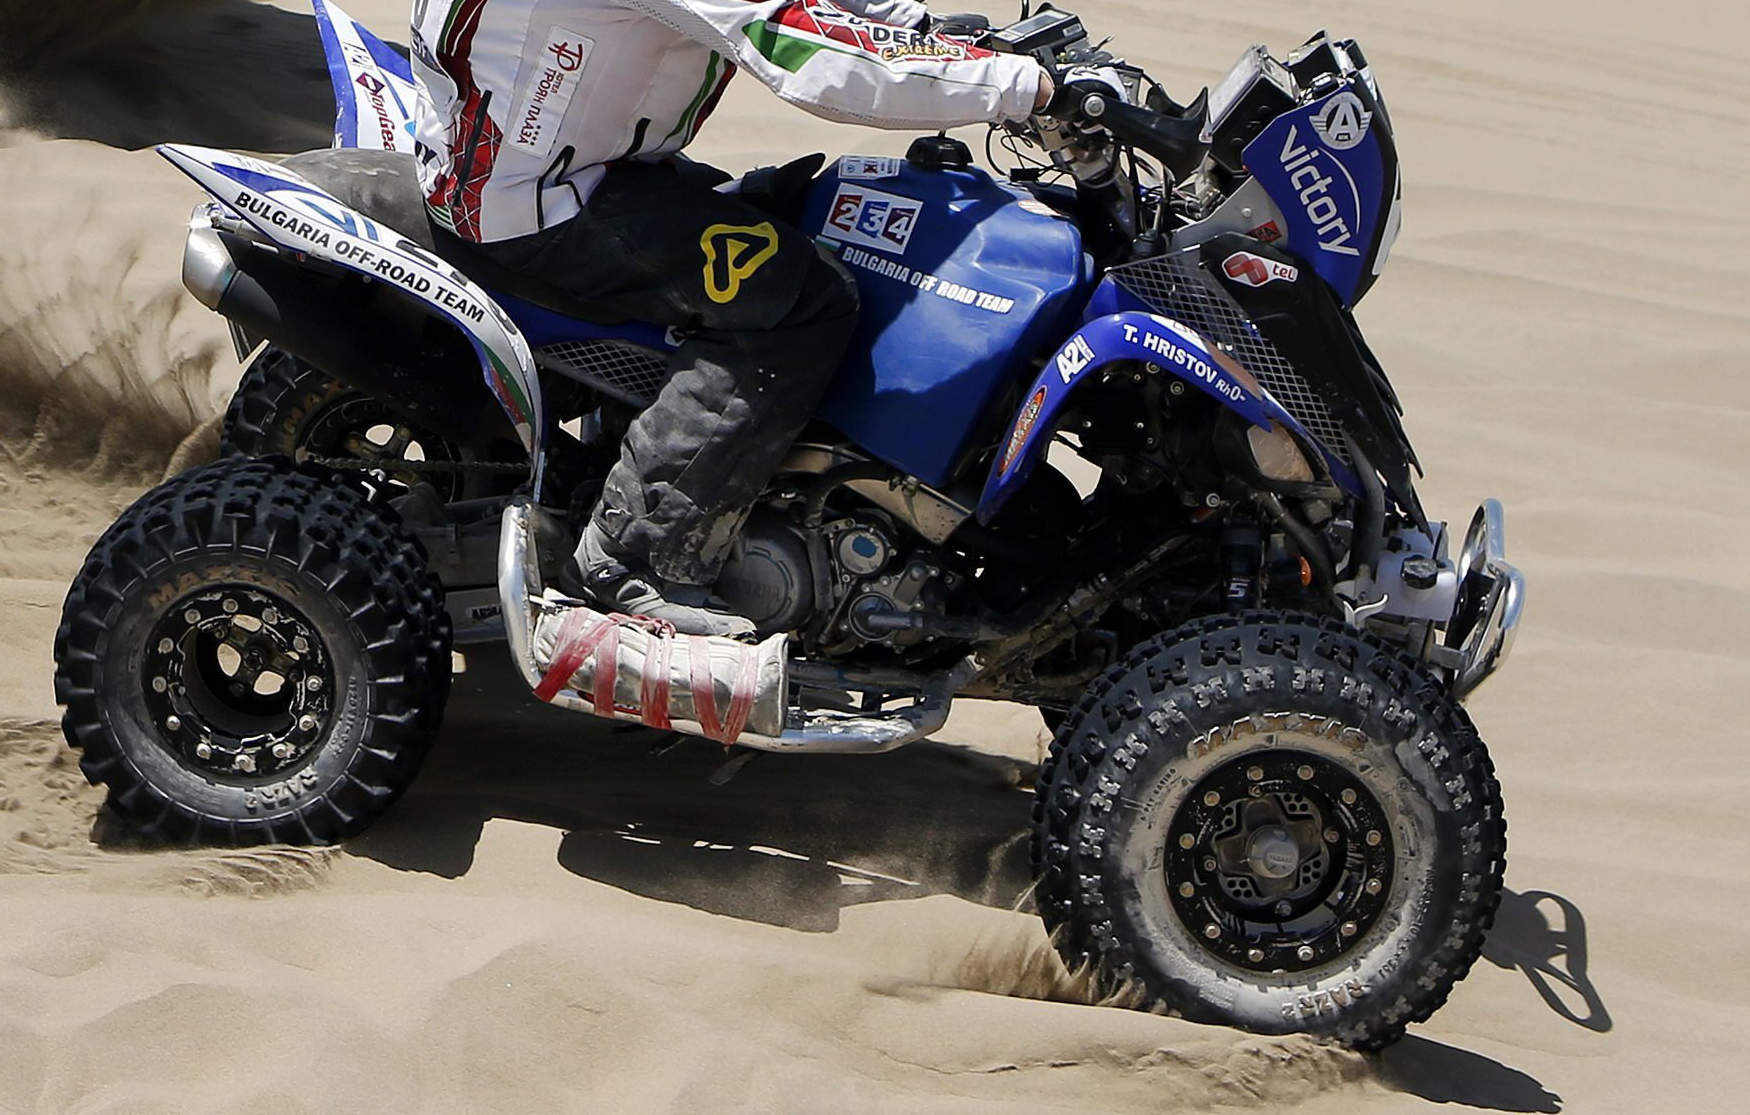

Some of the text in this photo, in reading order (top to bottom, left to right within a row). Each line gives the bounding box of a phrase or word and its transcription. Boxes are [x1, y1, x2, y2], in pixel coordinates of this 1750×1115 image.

[370, 90, 396, 152] TopGea
[517, 67, 558, 144] ТРОЯН ПЛАЗА
[234, 191, 486, 323] BULGARIA OFF-ROAD TEAM
[842, 246, 1015, 315] BULGARIA OFF ROAD TEAM
[1273, 264, 1295, 281] tel
[1123, 324, 1139, 344] T.
[1143, 331, 1218, 384] HRISTOV
